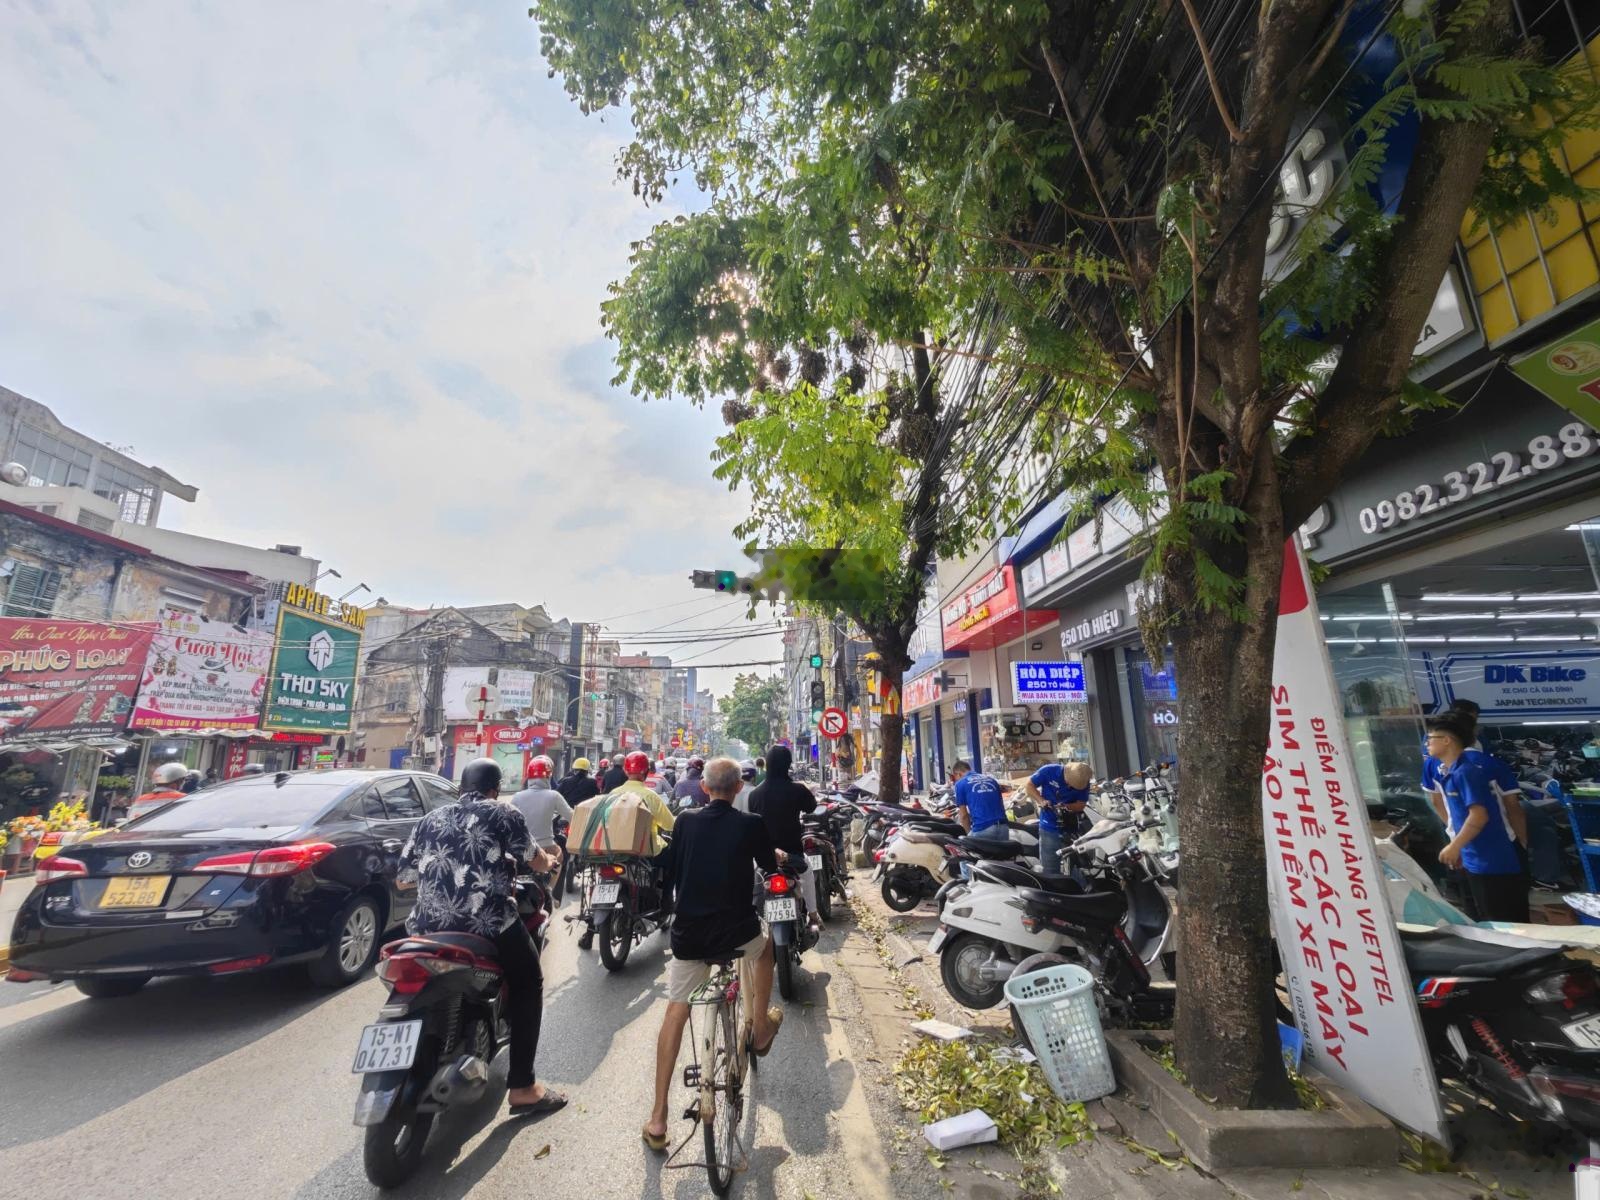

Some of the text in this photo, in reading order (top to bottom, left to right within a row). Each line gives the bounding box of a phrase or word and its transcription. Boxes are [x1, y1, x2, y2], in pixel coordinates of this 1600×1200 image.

[286, 582, 331, 616] APPLE
[341, 602, 369, 630] SAM
[1060, 628, 1077, 649] 250
[1092, 608, 1120, 635] HIỆU
[0, 644, 71, 673] PHÚC
[281, 672, 350, 699] THO SKY
[1019, 665, 1046, 680] HÒA
[1027, 681, 1047, 689] 250
[1484, 664, 1587, 684] DK Bike
[1049, 691, 1058, 699] XE
[1494, 697, 1588, 707] JAPAN TECHNOLOGY
[1271, 684, 1370, 1037] SIM THẺ CÁC LOẠI
[1310, 716, 1395, 1007] ĐIỂM BÁN HÀNG VIETTEL
[1261, 736, 1348, 1072] ẢO HIỂM XE MÁY
[371, 1023, 412, 1047] 15-N1
[356, 1045, 412, 1070] 047.31
